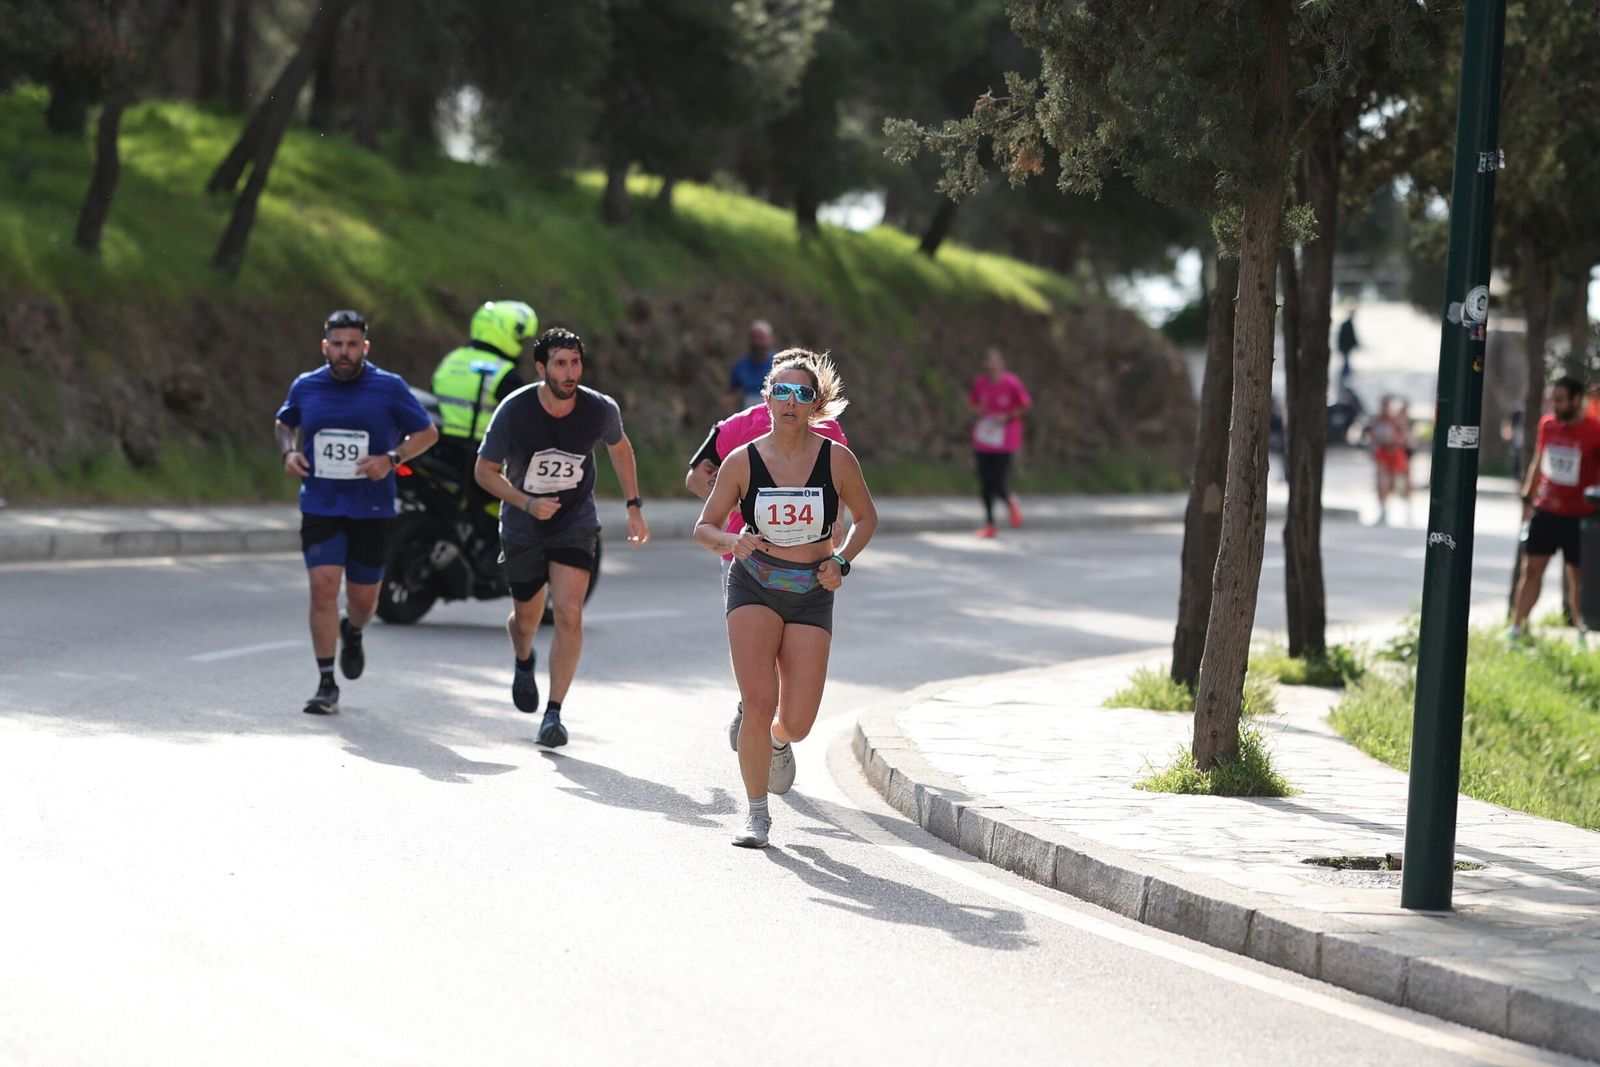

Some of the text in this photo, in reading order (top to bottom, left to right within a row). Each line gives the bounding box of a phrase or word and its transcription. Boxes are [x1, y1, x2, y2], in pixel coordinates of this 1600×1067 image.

[322, 443, 359, 461] 439
[537, 460, 575, 478] 523
[767, 503, 814, 526] 134
